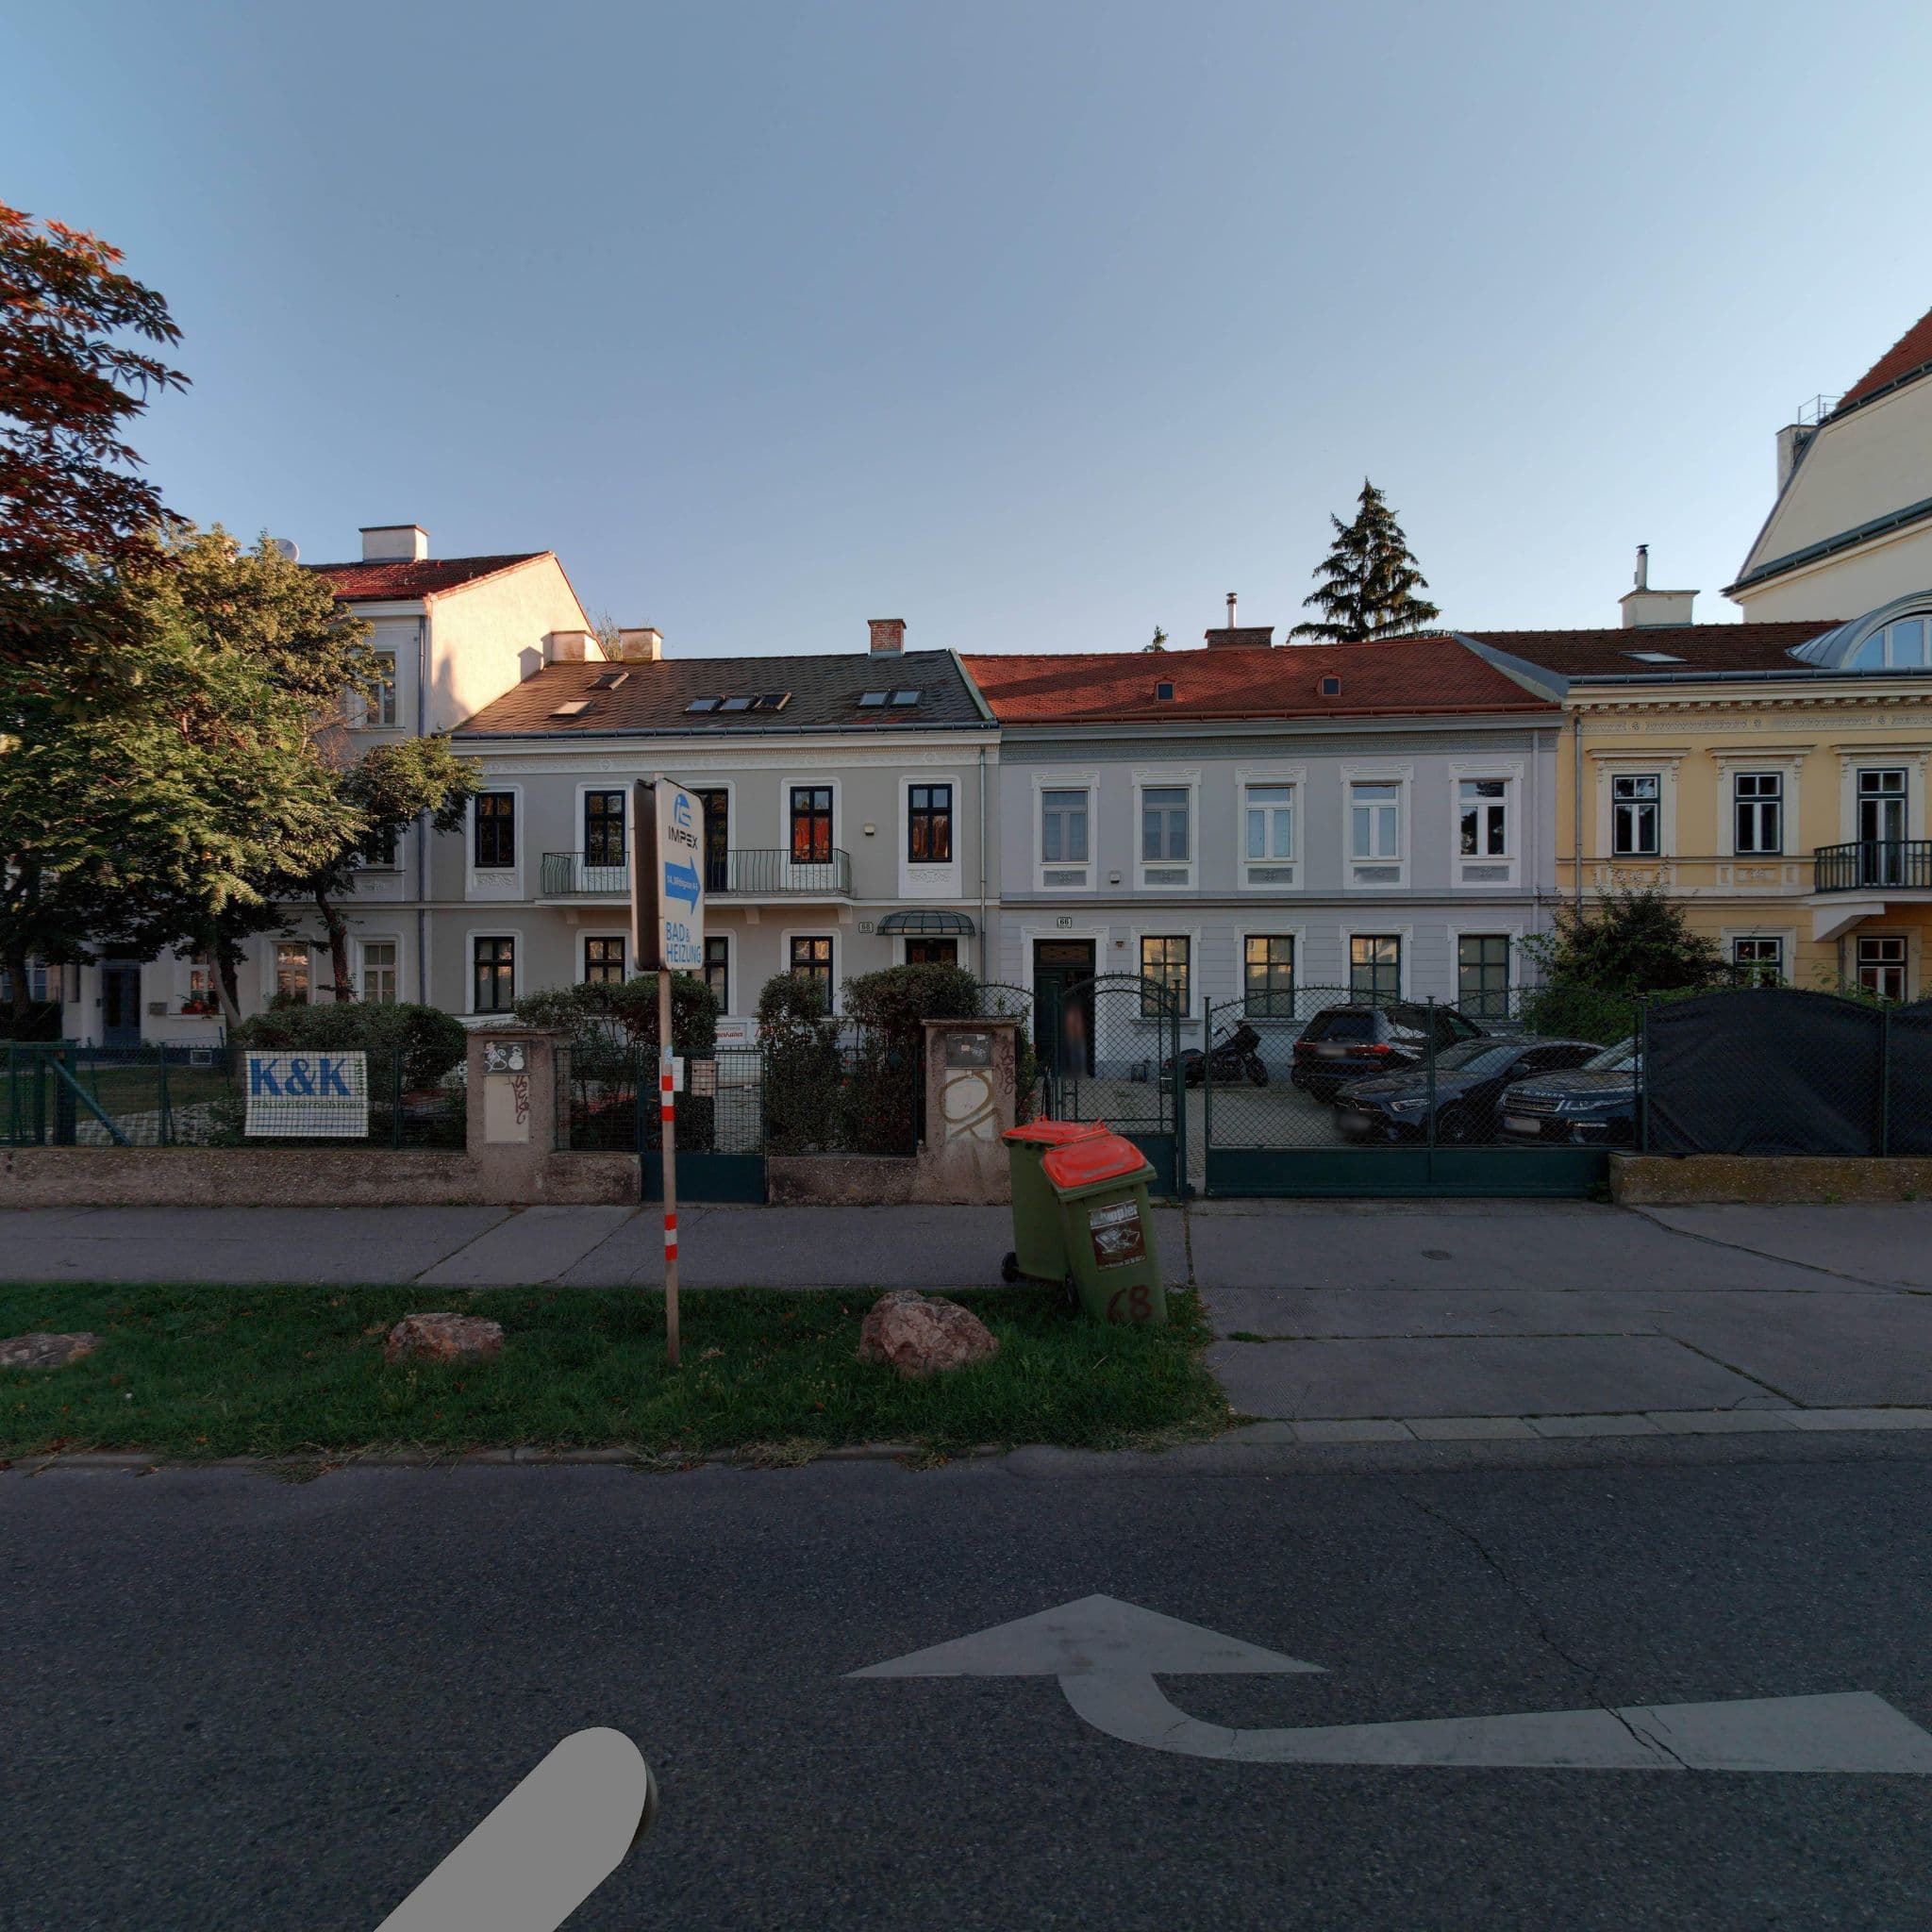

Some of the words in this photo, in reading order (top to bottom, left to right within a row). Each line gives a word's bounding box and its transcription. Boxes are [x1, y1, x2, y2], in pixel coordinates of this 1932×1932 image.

[668, 825, 698, 850] IMPEX
[665, 921, 685, 941] BAD
[666, 944, 701, 962] HEIZUNG
[250, 1058, 351, 1095] K&K
